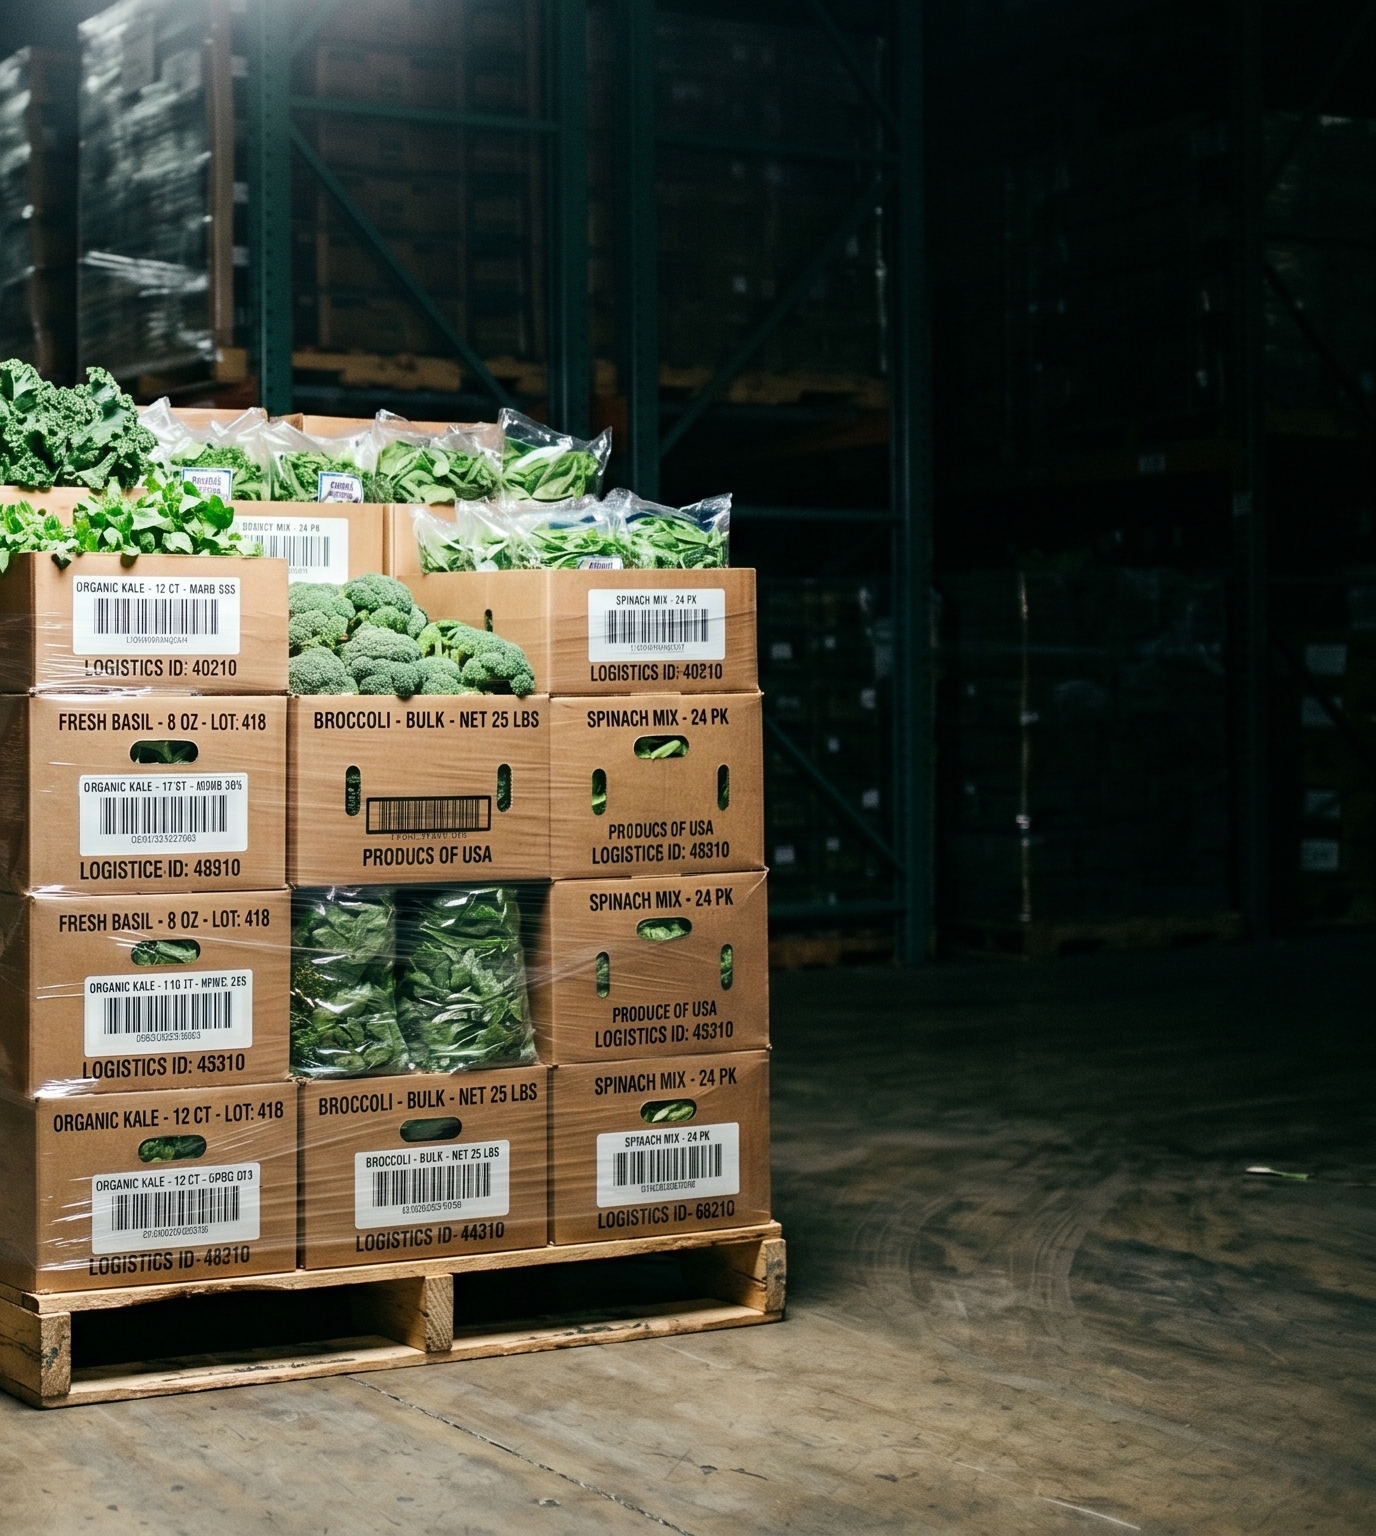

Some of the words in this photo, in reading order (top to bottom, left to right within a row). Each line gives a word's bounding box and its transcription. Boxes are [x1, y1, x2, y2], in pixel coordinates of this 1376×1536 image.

[277, 523, 290, 531] MIX
[76, 582, 118, 593] ORGANIC
[122, 582, 145, 593] KALE
[156, 583, 166, 594] 12
[168, 583, 181, 594] CT
[616, 595, 650, 605] SPINACH
[653, 595, 668, 605] MIX
[676, 595, 685, 604] 24
[84, 659, 164, 677] LOGISTICS
[168, 660, 188, 676] ID:
[192, 659, 237, 676] 40210
[591, 664, 659, 682] LOGISTICS
[58, 714, 107, 730] FRESH
[112, 714, 154, 730] BASIL
[168, 714, 176, 730] 8
[180, 714, 198, 730] OZ
[211, 714, 239, 730] LOT:
[242, 714, 266, 730] 418
[314, 711, 391, 729] BROCCOLI
[406, 711, 445, 729] BULK
[460, 711, 487, 728] NET
[492, 711, 509, 728] 25
[513, 711, 540, 728] LBS
[587, 710, 649, 728] SPINACH
[653, 709, 679, 726] MIX
[691, 709, 707, 725] 24
[711, 708, 729, 725] PK
[84, 782, 126, 793] ORGANIC
[129, 781, 152, 792] KALE
[609, 822, 667, 839] PRODUCS
[671, 821, 686, 836] OF
[690, 820, 714, 835] USA
[363, 847, 434, 866] PRODUCS
[439, 846, 458, 864] OF
[463, 845, 492, 863] USA
[668, 843, 685, 860] ID:
[690, 841, 729, 859] 48310
[168, 859, 189, 878] ID:
[590, 892, 652, 911] SPINACH
[656, 890, 682, 908] MIX
[695, 889, 711, 906] 24
[716, 888, 733, 906] PK
[59, 914, 107, 932] FRESH
[112, 912, 153, 931] BASIL
[168, 912, 176, 930] 8
[180, 911, 199, 929] OZ
[212, 910, 240, 928] LOT:
[245, 909, 270, 927] 418
[90, 982, 130, 994] ORGANIC
[133, 980, 155, 992] KALE
[613, 1004, 670, 1023] PRODUCE
[674, 1003, 689, 1018] OF
[693, 1001, 717, 1017] USA
[595, 1026, 667, 1048] LOGISTICS
[672, 1025, 689, 1043] ID:
[82, 1057, 167, 1079] LOGISTICS
[172, 1056, 192, 1075] ID:
[595, 1073, 656, 1096] SPINACH
[660, 1071, 686, 1090] MIX
[699, 1069, 715, 1087] 24
[720, 1067, 737, 1085] PK
[319, 1093, 393, 1115] BROCCOLI
[407, 1090, 445, 1109] BULK
[459, 1087, 486, 1106] NET
[491, 1085, 507, 1103] 25
[512, 1083, 538, 1102] LBS
[54, 1112, 119, 1132] ORGANIC
[124, 1109, 160, 1129] KALE
[173, 1107, 190, 1126] 12
[194, 1106, 212, 1124] CT
[225, 1104, 254, 1122] LOT:
[258, 1101, 284, 1120] 418
[687, 1132, 698, 1142] 24
[700, 1131, 710, 1141] PK
[366, 1154, 411, 1168] BROCCOLI
[420, 1152, 443, 1163] BULK
[452, 1149, 469, 1161] NET
[471, 1148, 481, 1159] 25
[96, 1178, 139, 1192] ORGANIC
[142, 1176, 165, 1188] KALE
[174, 1174, 186, 1186] 12
[188, 1173, 200, 1185] CT
[598, 1206, 669, 1229] LOGISTICS
[696, 1200, 735, 1220] 68210
[356, 1228, 432, 1253] LOGISTICS
[461, 1221, 505, 1241] 44310
[89, 1252, 173, 1276] LOGISTICS
